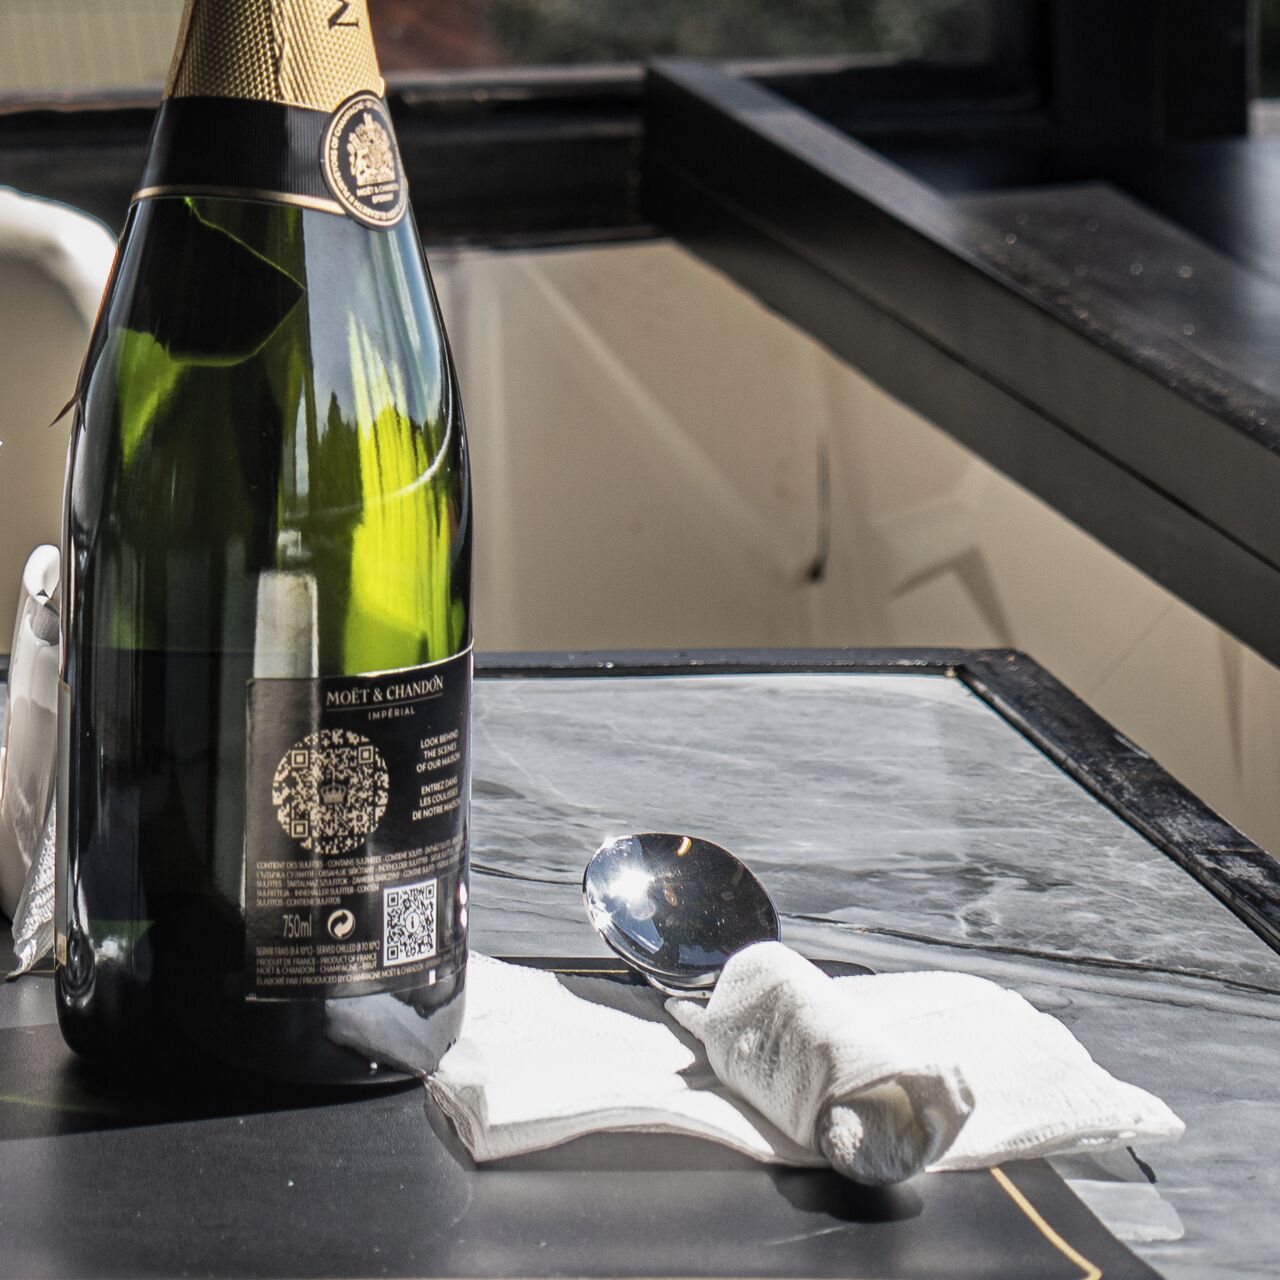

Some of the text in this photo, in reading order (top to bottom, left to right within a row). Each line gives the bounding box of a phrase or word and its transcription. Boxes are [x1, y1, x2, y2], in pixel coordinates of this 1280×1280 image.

[326, 675, 444, 706] MOËT & CHANDON
[368, 706, 415, 720] IMPÉRIAL
[420, 729, 459, 749] LOOK BEHIND
[423, 742, 457, 759] THE SCENES
[416, 752, 460, 773] OF OUR MAISON
[421, 775, 458, 795] ENTREZ DANS
[420, 787, 459, 807] LES COULISSES
[412, 810, 422, 821] DE
[422, 804, 444, 818] NOTRE
[282, 913, 312, 938] 750ml
[282, 965, 316, 974] CHANDON
[320, 955, 347, 965] PRODUCT
